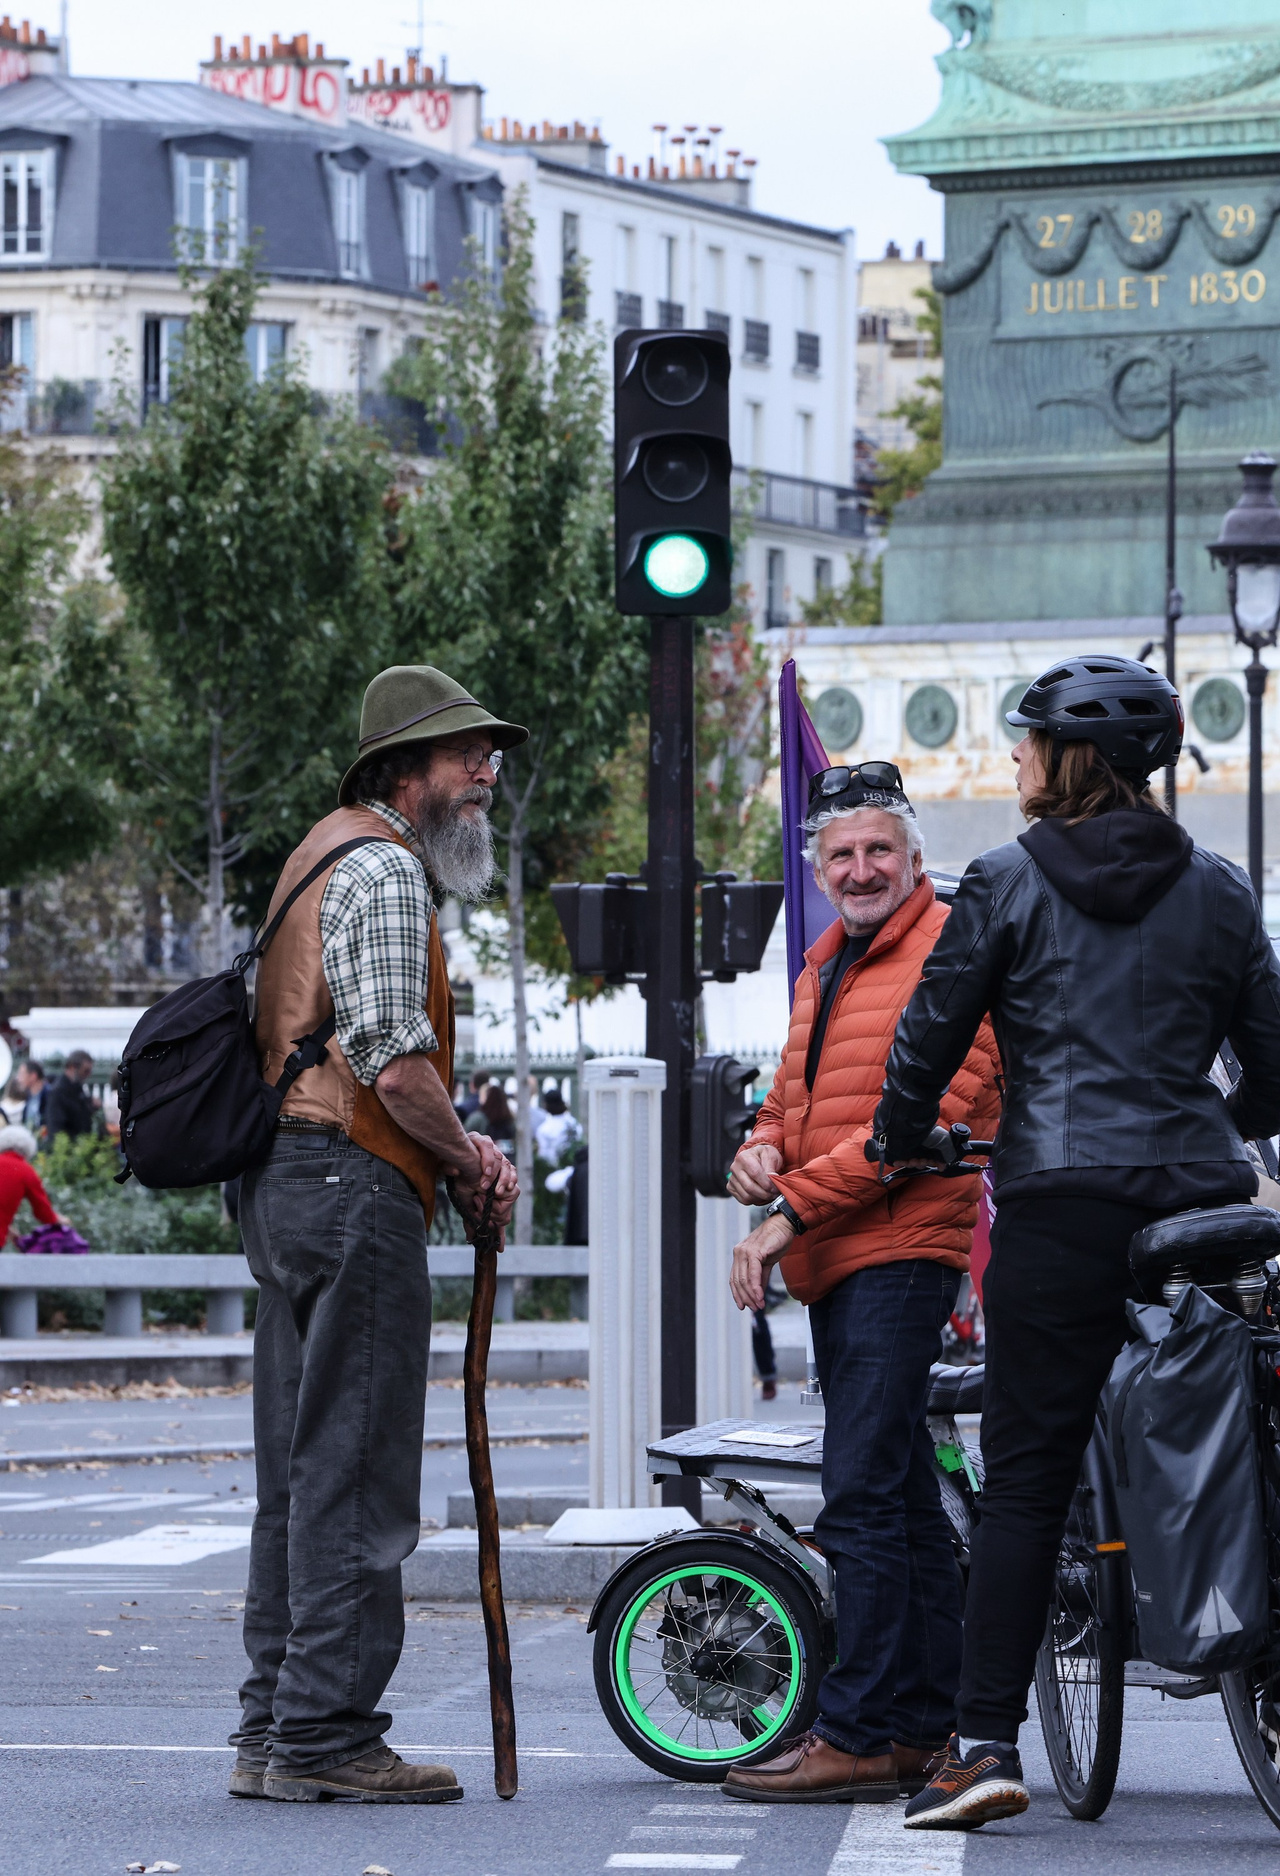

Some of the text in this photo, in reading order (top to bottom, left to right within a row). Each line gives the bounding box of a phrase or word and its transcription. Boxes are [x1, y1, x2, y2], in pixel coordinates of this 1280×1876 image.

[1037, 203, 1257, 248] 27 28 29
[1024, 269, 1266, 315] JUILLET 1830
